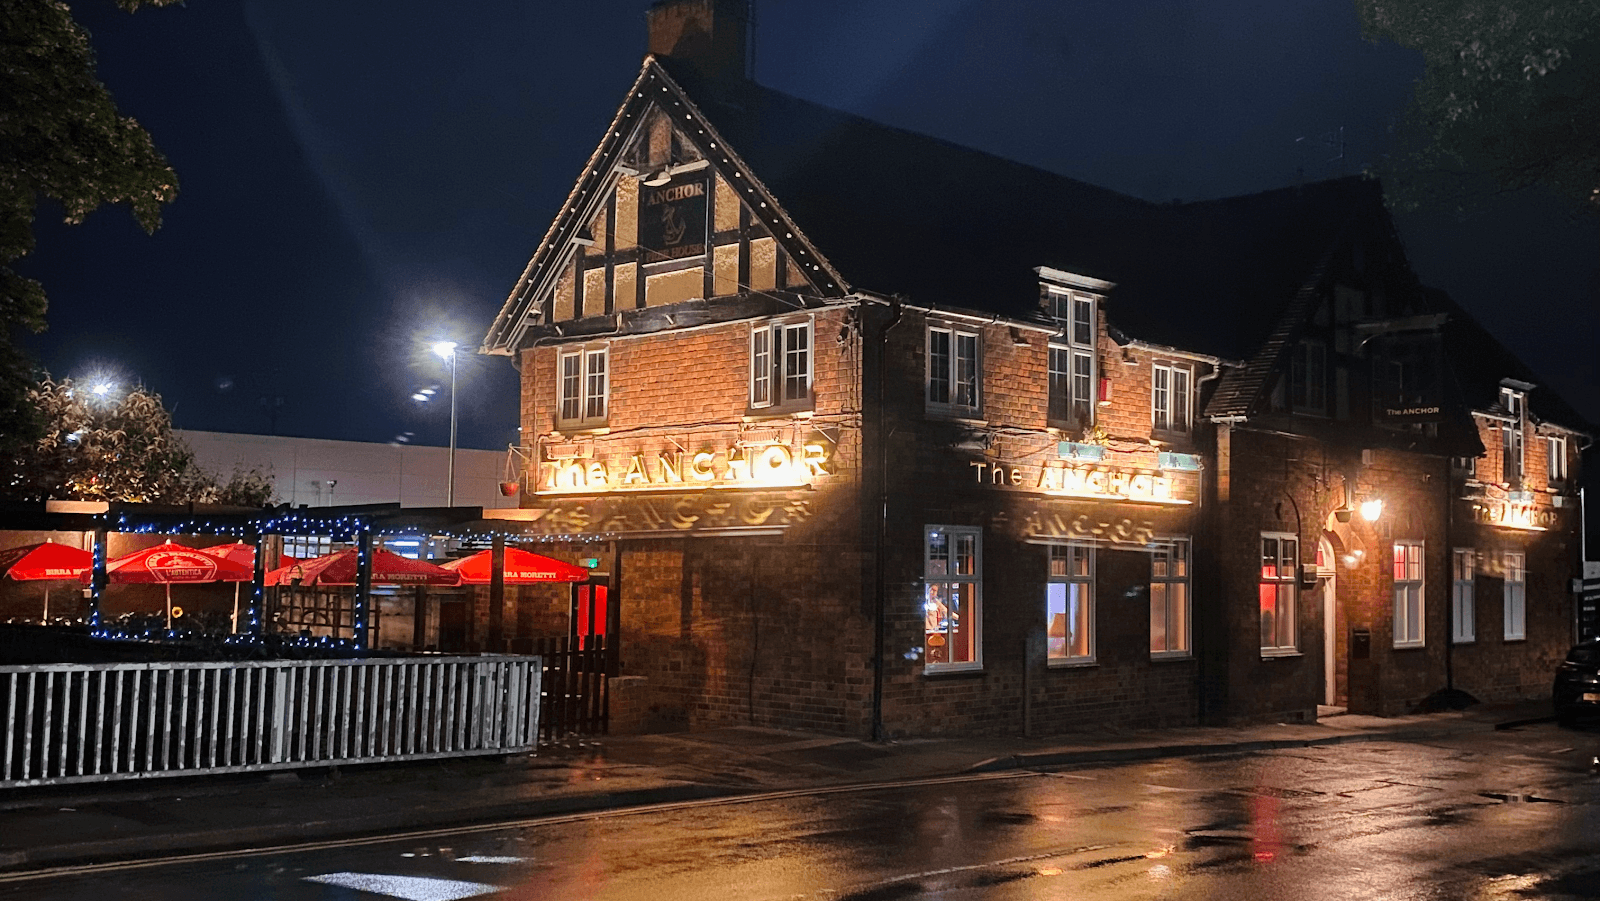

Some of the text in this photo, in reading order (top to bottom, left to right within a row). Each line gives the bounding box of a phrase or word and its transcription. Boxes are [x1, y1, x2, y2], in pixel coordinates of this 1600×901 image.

[649, 182, 705, 205] ANCHOR
[671, 244, 704, 257] HOUSE
[1403, 407, 1440, 415] ANCHOR
[541, 444, 831, 487] The ANCHOR
[969, 461, 1173, 497] The ANCHOR
[45, 568, 71, 576] BIRRA
[520, 571, 556, 579] MORETTI
